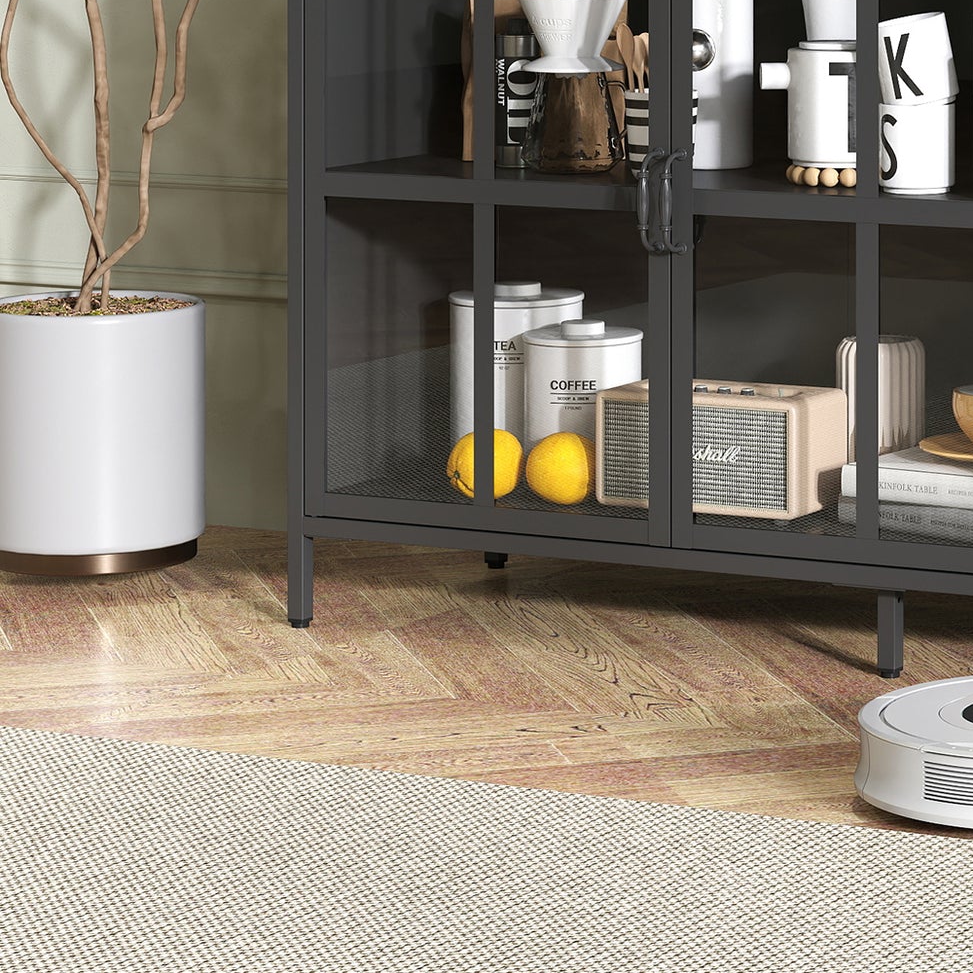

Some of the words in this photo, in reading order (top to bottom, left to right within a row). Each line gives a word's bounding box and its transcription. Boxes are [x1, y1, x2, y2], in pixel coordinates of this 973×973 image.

[884, 32, 924, 100] K
[497, 58, 505, 107] WALNUT
[494, 340, 517, 351] TEA
[550, 380, 597, 391] COFFEE
[692, 444, 741, 462] shall
[878, 482, 913, 492] KINFOLK
[914, 485, 938, 495] TABLE
